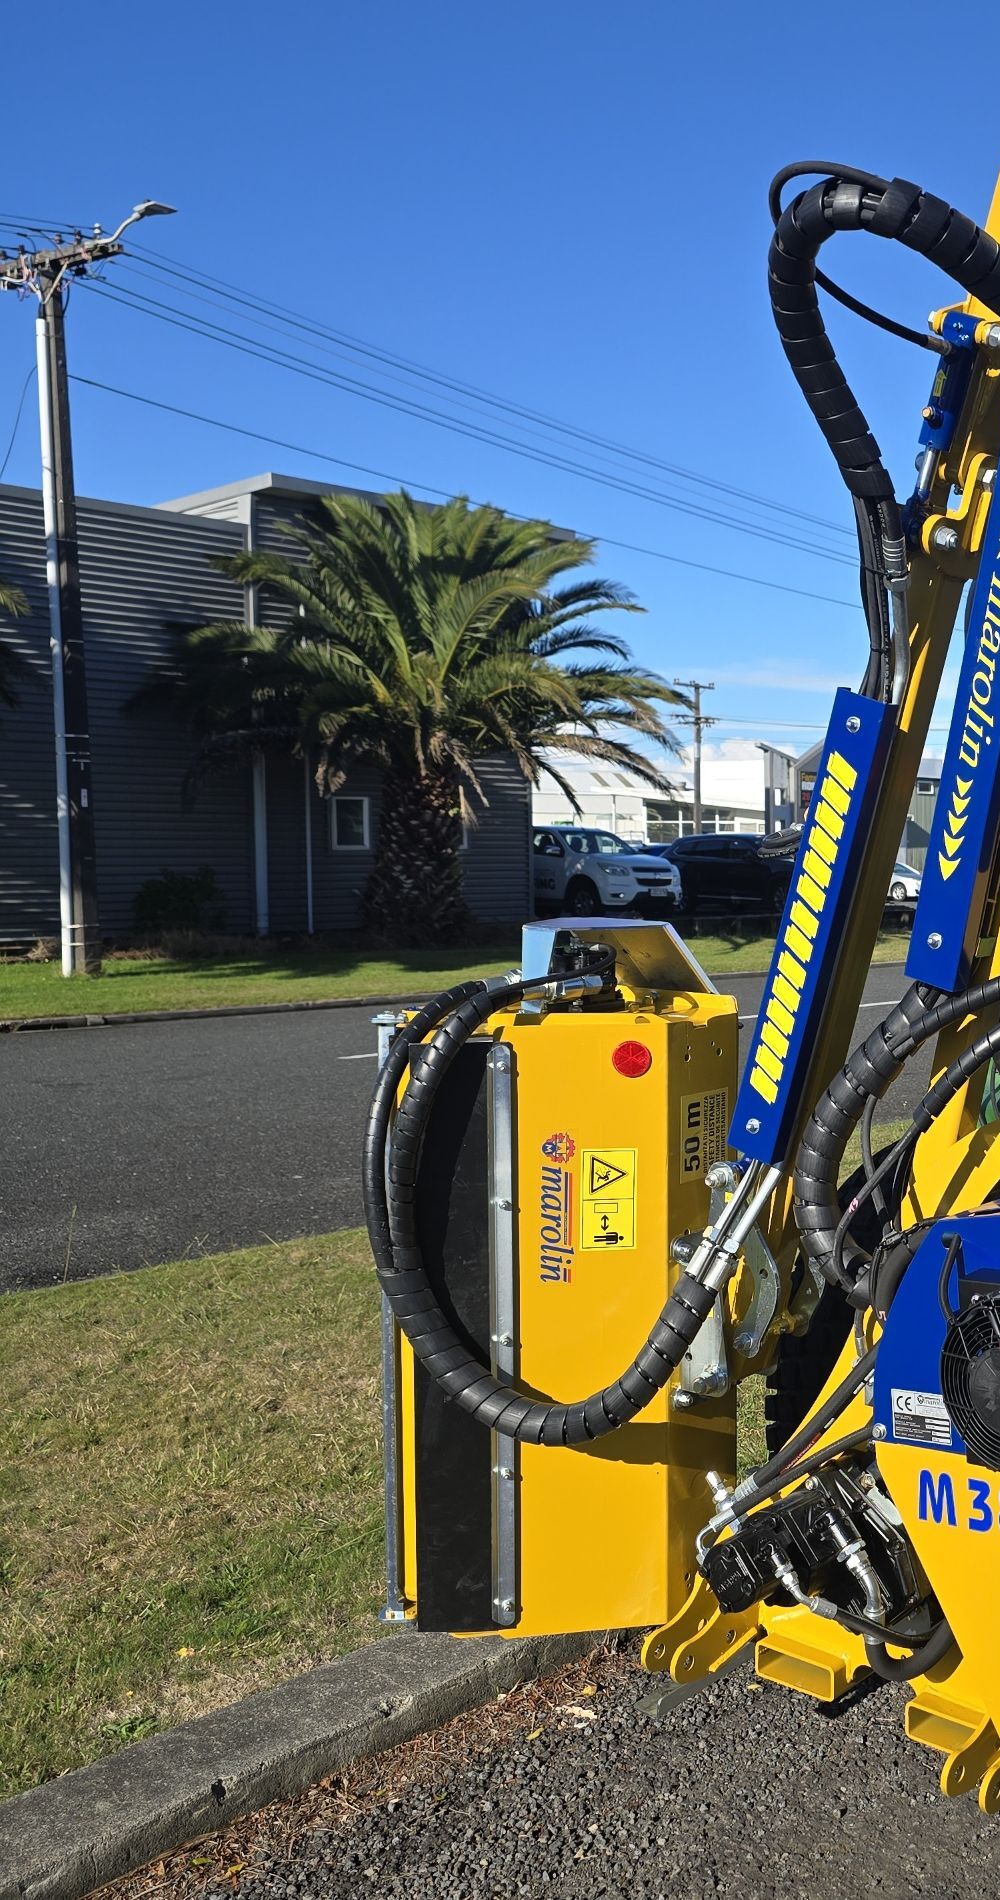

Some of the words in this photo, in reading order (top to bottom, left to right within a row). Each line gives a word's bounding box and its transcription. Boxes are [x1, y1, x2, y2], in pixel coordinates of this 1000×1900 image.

[687, 1101, 701, 1128] m
[708, 1095, 716, 1137] DISTANCE
[684, 1136, 700, 1172] 50
[540, 1166, 574, 1282] marolin
[918, 1469, 957, 1527] M
